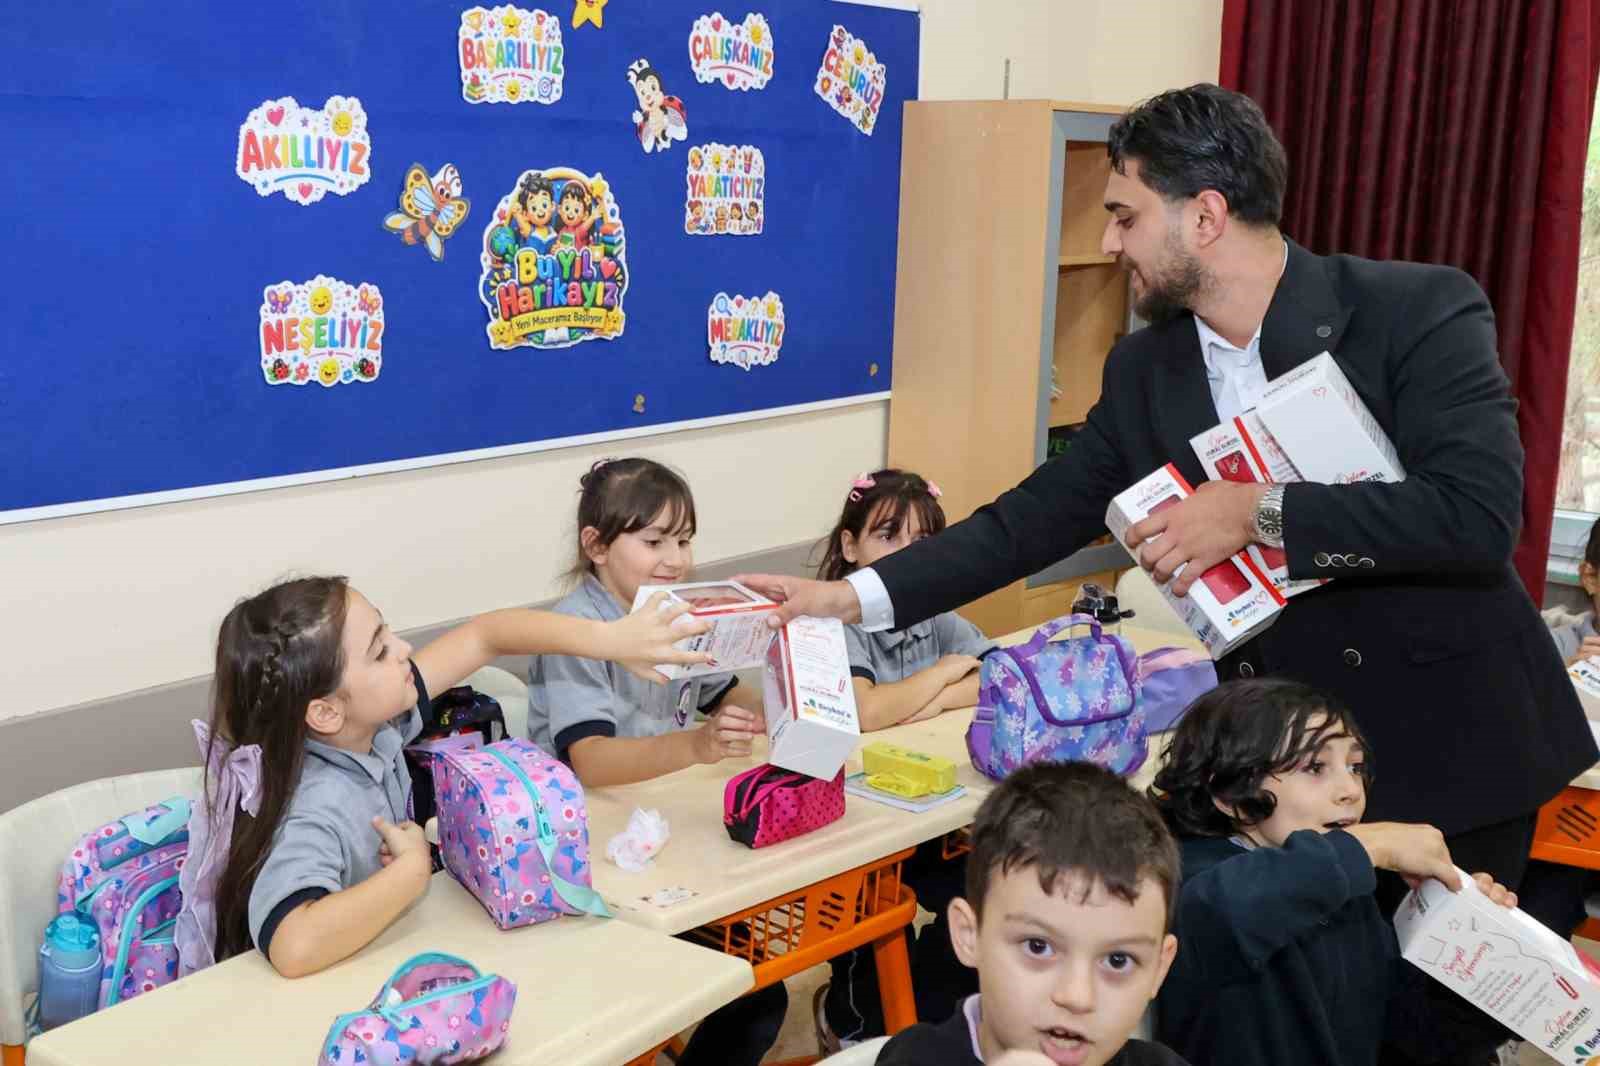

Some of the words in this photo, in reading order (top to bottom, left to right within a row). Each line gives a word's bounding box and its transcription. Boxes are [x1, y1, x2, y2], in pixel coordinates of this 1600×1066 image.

[463, 38, 562, 75] BAŞARILIYIZ
[691, 33, 772, 76] ÇALIŞKANIZ
[824, 47, 881, 113] CESURUZ
[242, 129, 367, 175] AKILLIYIZ
[688, 174, 763, 200] YARATICIYIZ
[263, 310, 380, 356] NEŞELİYİZ
[710, 317, 784, 346] MERAKLIYIZ
